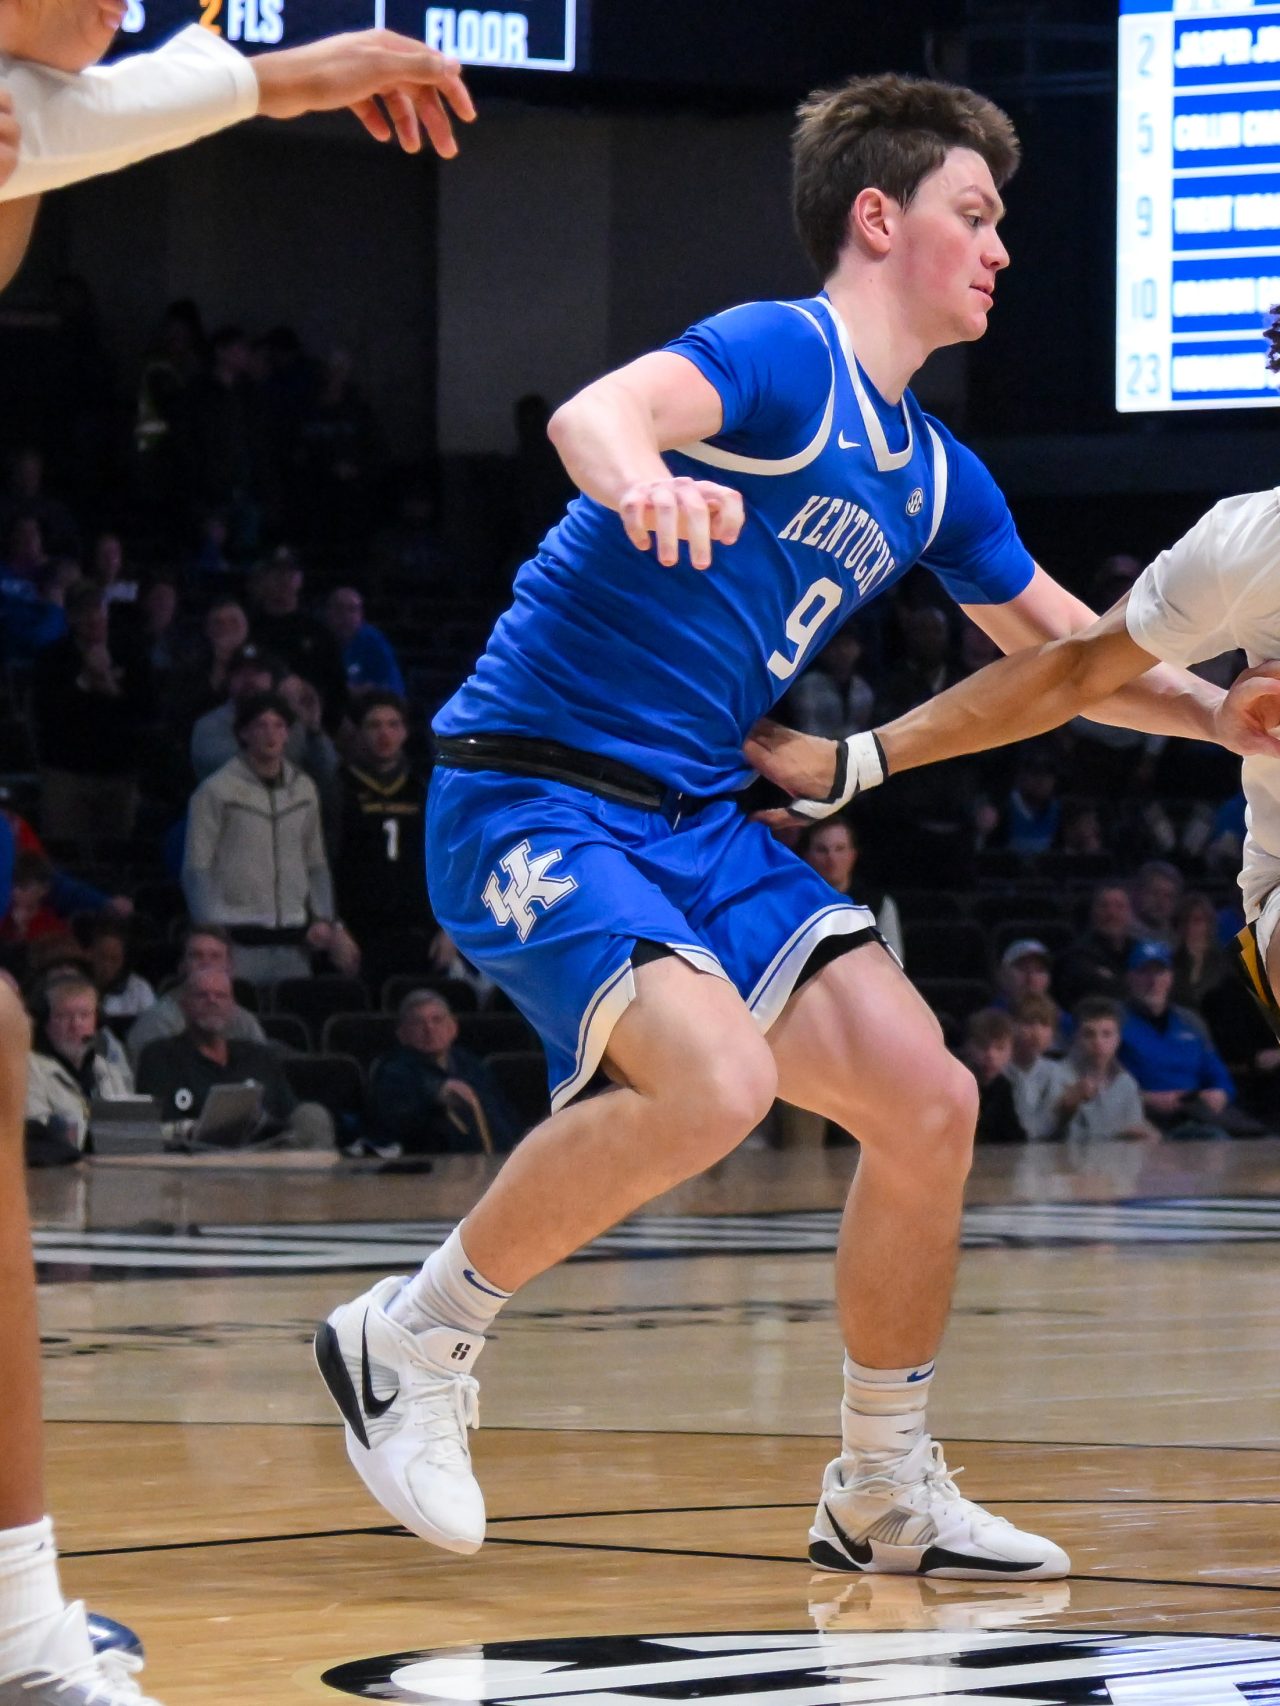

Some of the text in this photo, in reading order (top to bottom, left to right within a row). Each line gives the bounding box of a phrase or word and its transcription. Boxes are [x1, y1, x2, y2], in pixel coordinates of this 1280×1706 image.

[228, 0, 284, 44] FLS
[426, 8, 529, 63] FLOOR
[1137, 35, 1155, 78] 2
[1137, 111, 1155, 155] 5
[1136, 194, 1154, 238] 9
[1132, 278, 1158, 320] 10
[1127, 353, 1162, 396] 23
[778, 495, 896, 596] KENTUCKY
[767, 577, 843, 680] 9
[382, 818, 399, 861] 1
